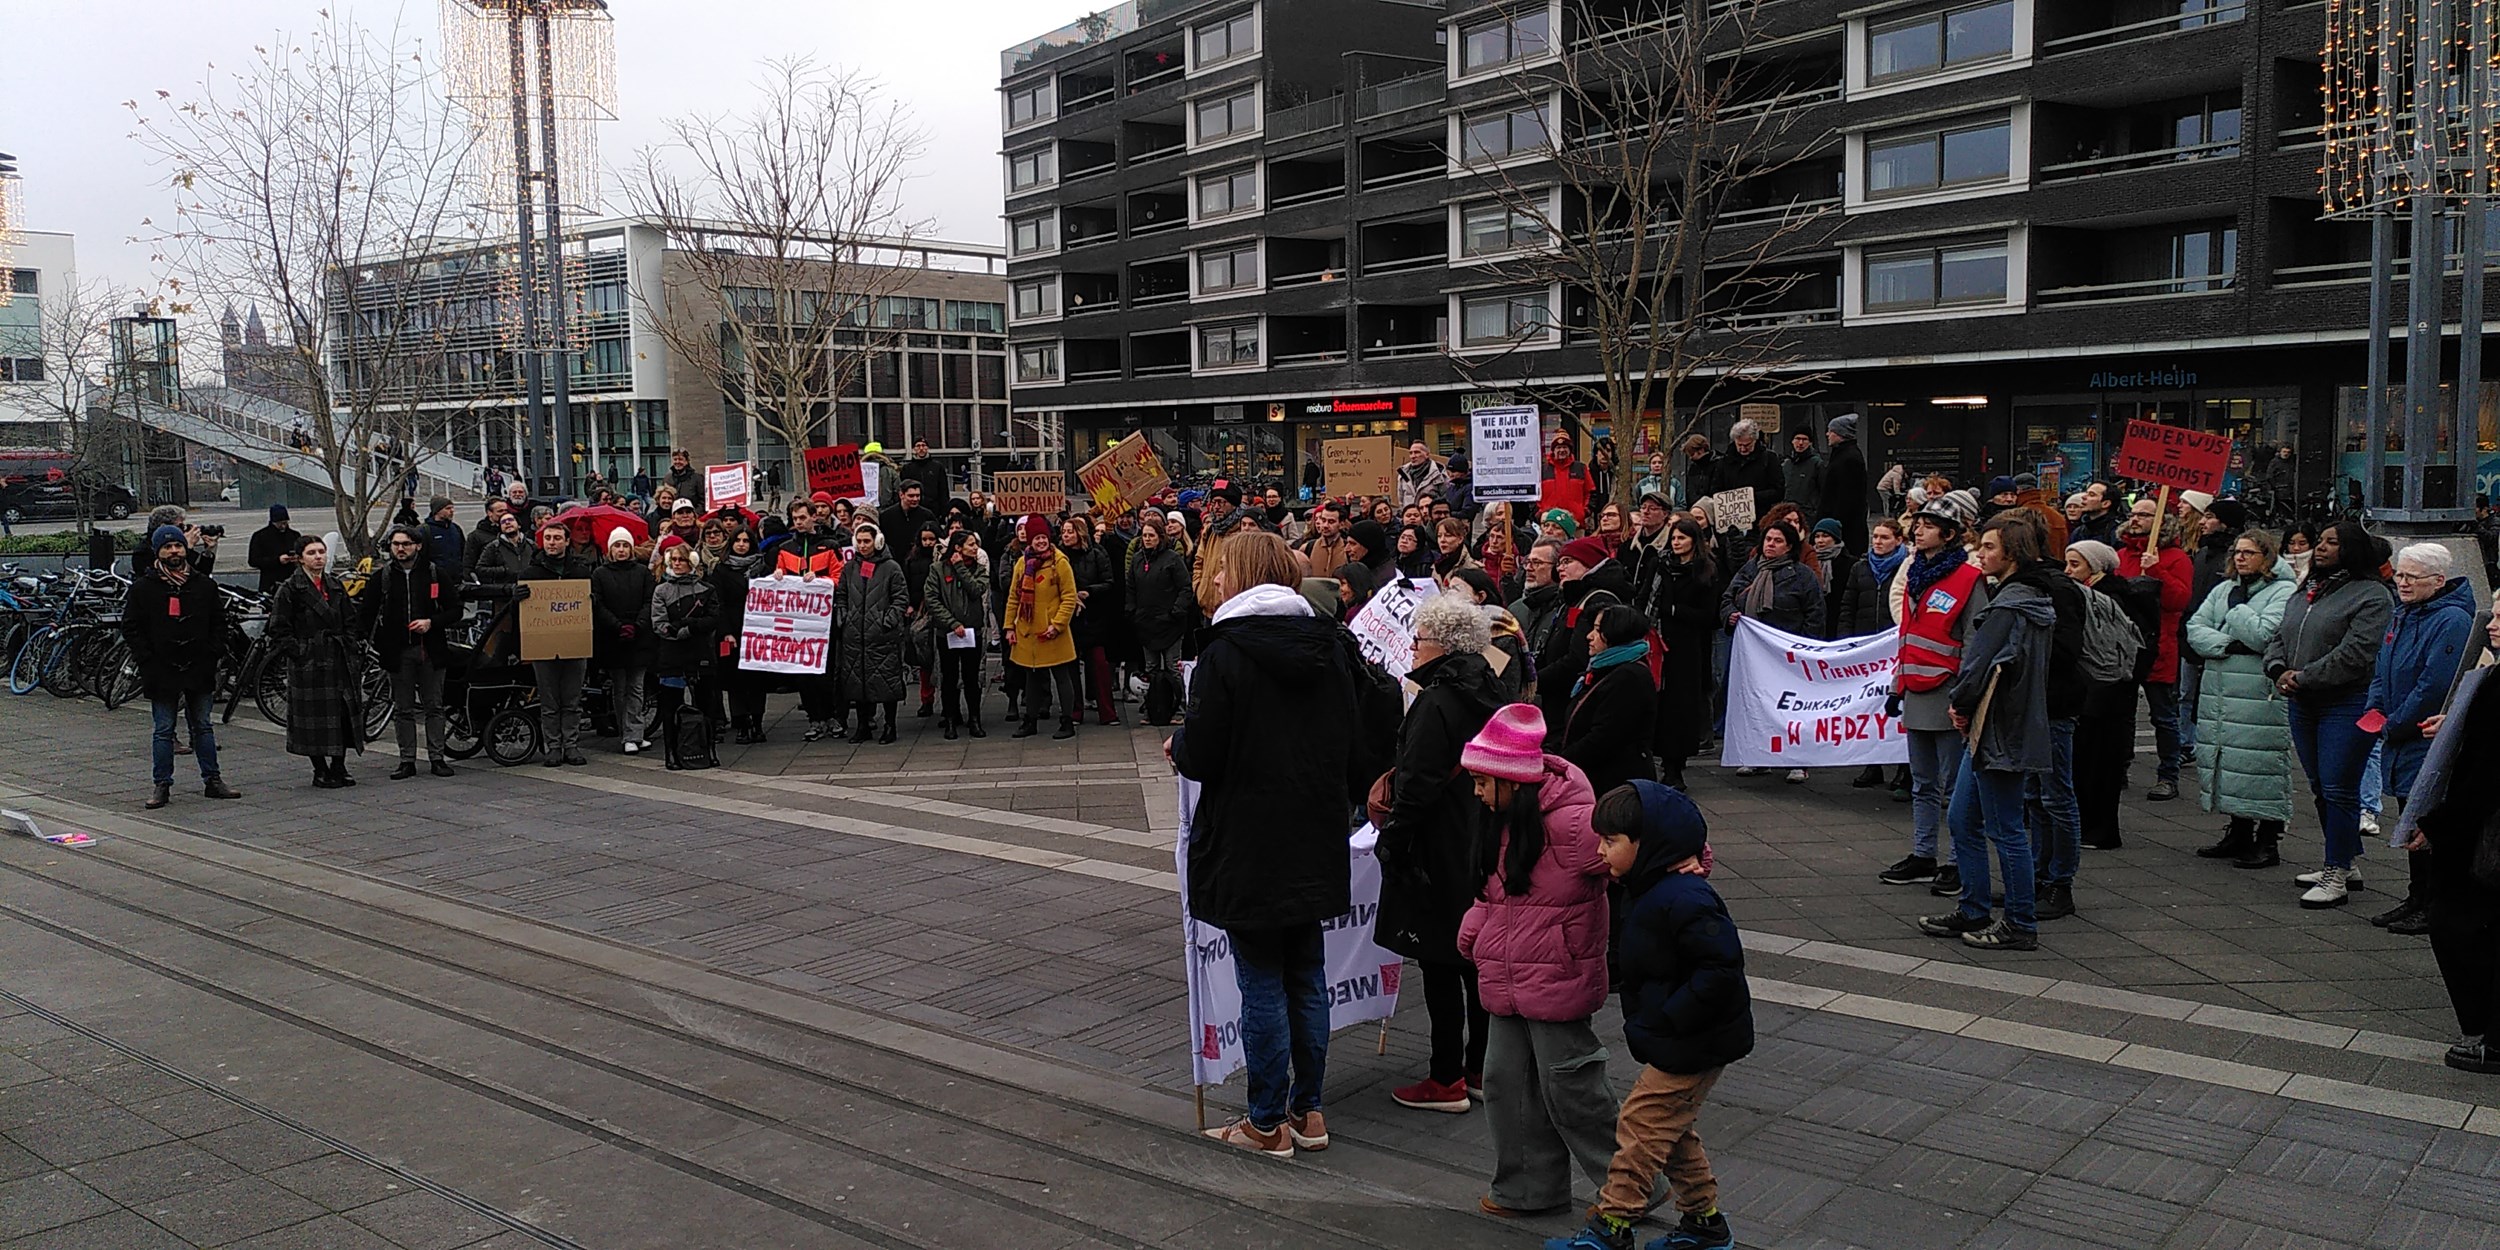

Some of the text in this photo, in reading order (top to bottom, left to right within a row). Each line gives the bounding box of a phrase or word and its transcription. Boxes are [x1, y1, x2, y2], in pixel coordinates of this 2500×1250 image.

[2090, 369, 2197, 388] Albert Heijn
[1306, 402, 1332, 413] reisburo
[1481, 415, 1529, 427] WIE RIJK IS
[1484, 427, 1526, 439] MAG SLIM
[2129, 424, 2226, 455] ONDERWIJS
[1492, 440, 1516, 451] ZIJN?
[2128, 456, 2214, 487] TOEKOMST
[997, 476, 1064, 492] NO MONEY
[998, 496, 1064, 512] NO BRAINY
[1717, 491, 1736, 505] STOP
[1718, 501, 1751, 518] SLOPEN
[550, 601, 582, 612] RECHT
[747, 586, 832, 617] ONDERWIJS
[742, 631, 829, 669] TOEKOMST
[1777, 690, 1852, 711] EDUKACJA
[1788, 713, 1889, 746] W NĘDZY
